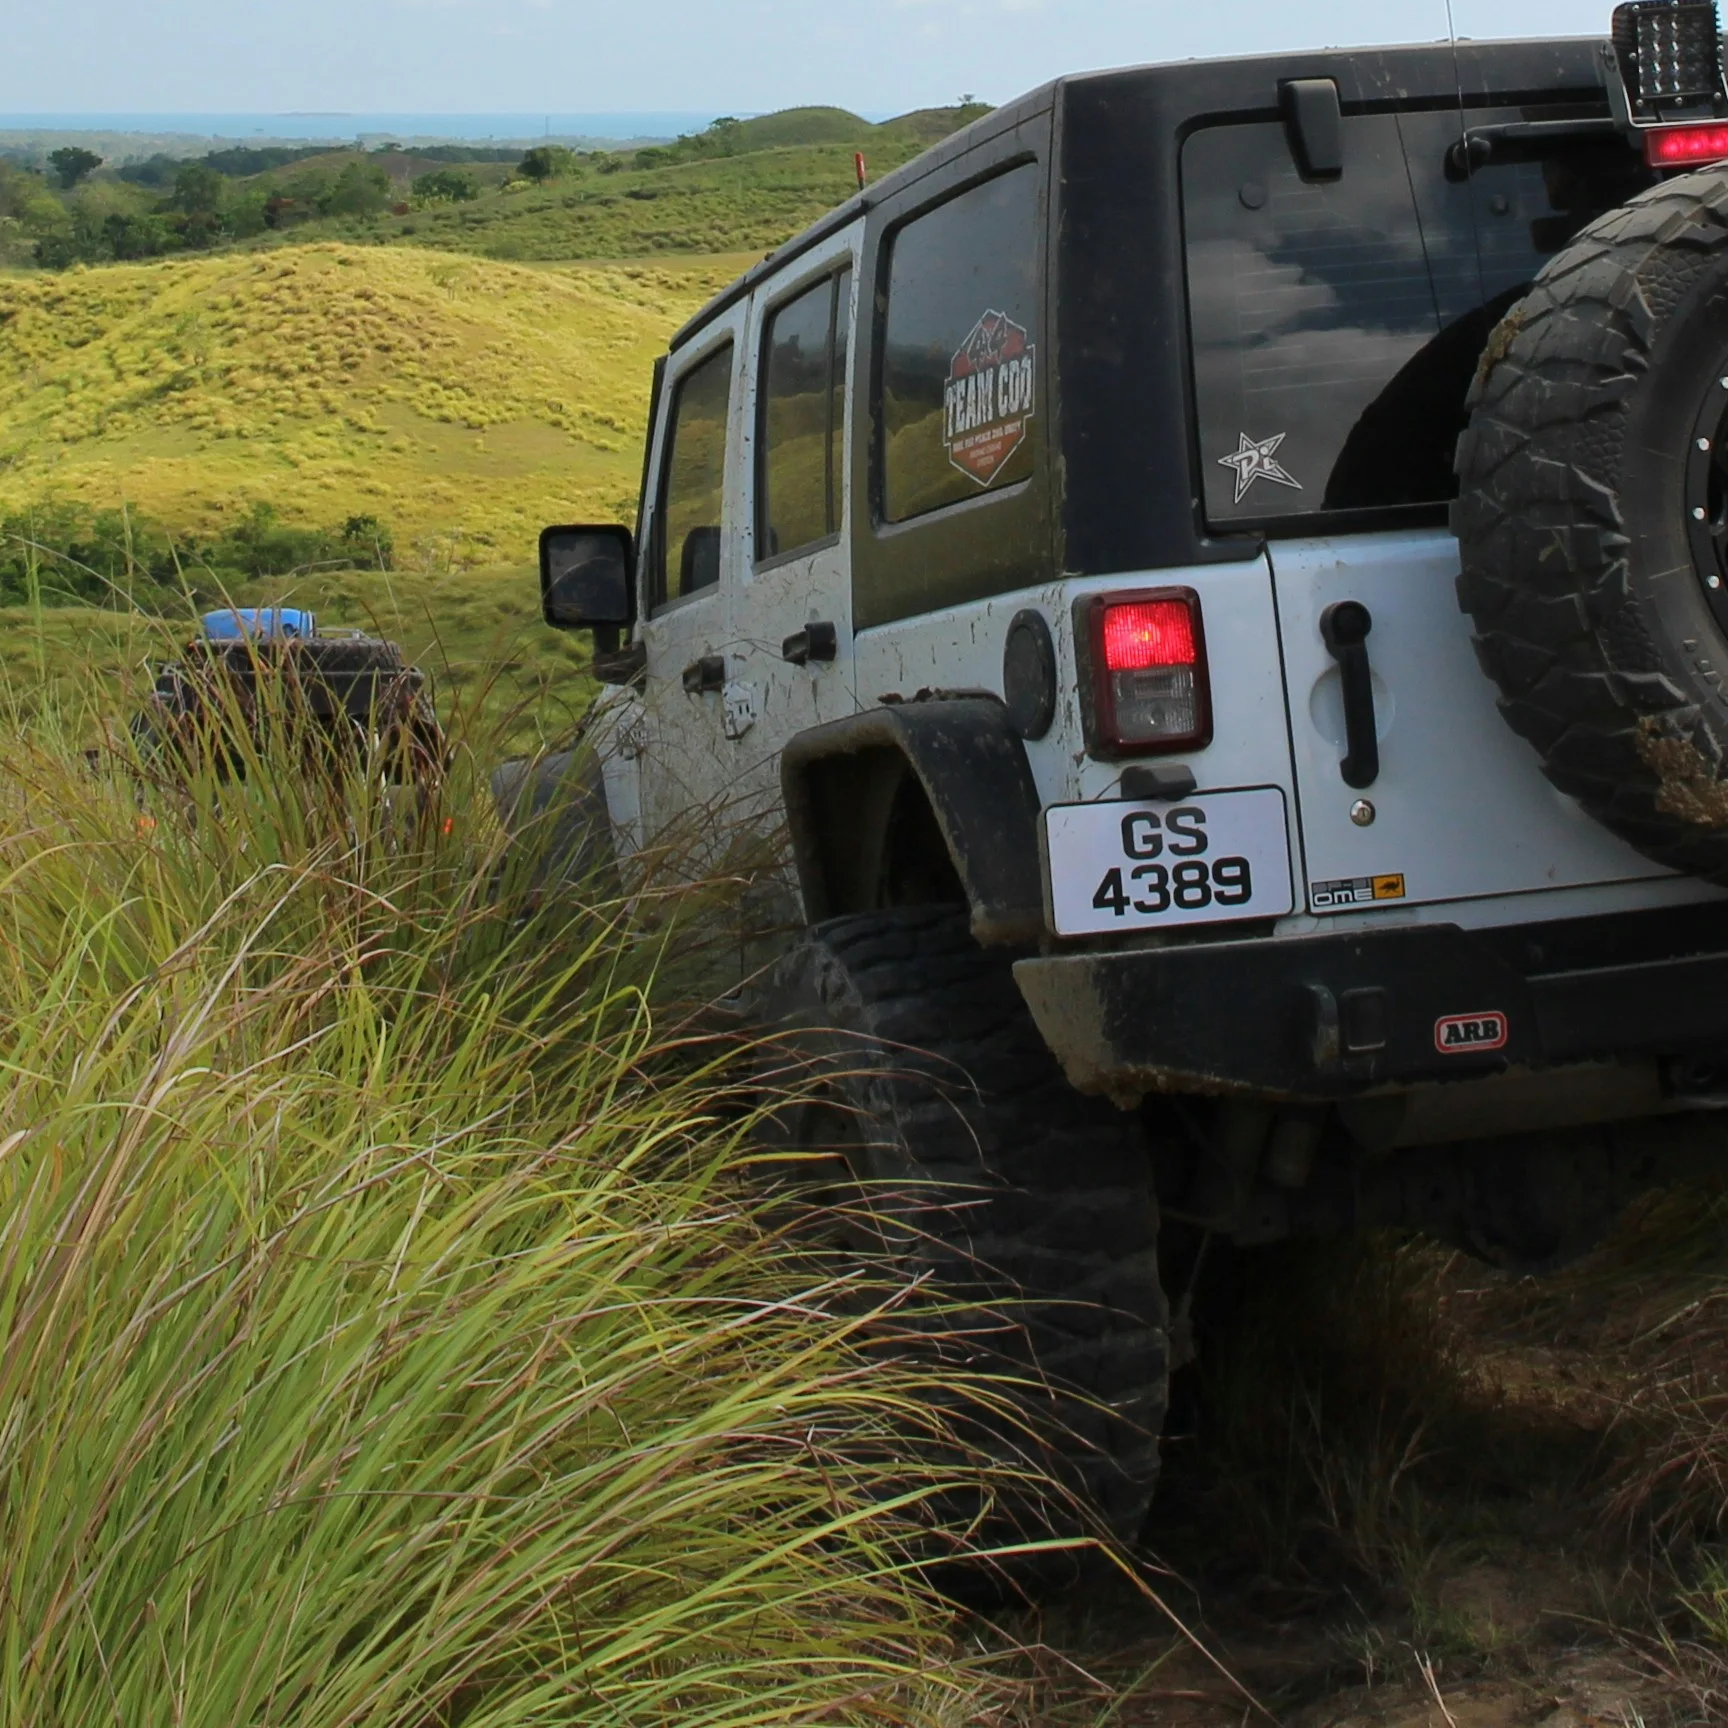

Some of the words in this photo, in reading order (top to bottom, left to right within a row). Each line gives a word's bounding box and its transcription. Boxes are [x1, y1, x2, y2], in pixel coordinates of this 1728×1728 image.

[945, 367, 994, 438] TEAM
[1120, 806, 1209, 861] GS
[1091, 855, 1253, 917] 4389
[1443, 1019, 1500, 1045] ARB
